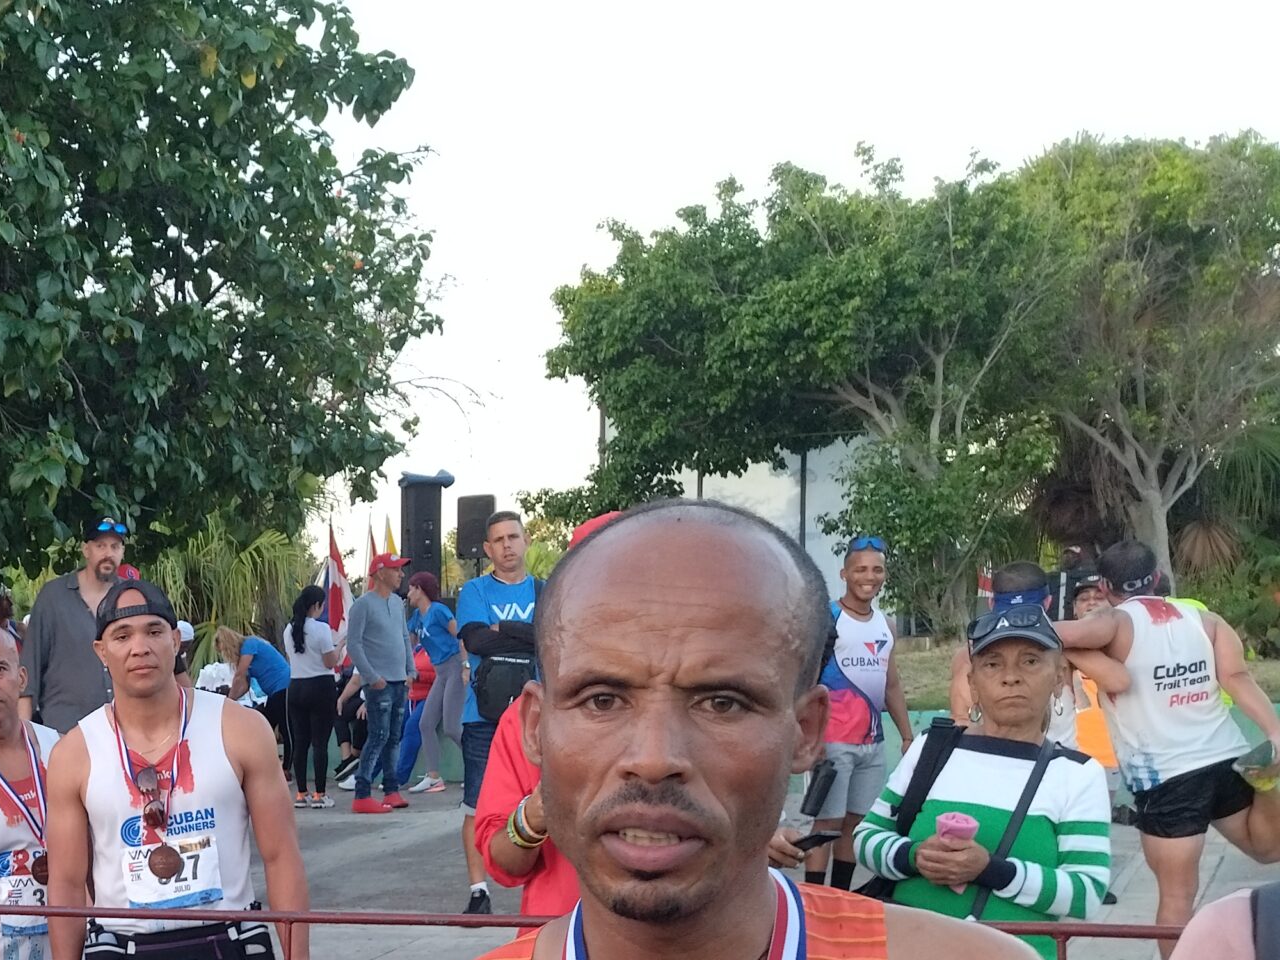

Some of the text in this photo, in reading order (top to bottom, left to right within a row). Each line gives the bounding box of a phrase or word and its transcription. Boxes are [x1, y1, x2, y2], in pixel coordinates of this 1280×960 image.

[1153, 659, 1207, 681] Cuban
[1154, 674, 1211, 692] Trail Team
[1169, 690, 1209, 708] Arian
[167, 807, 215, 827] CUBAN
[166, 820, 216, 837] RUNNERS
